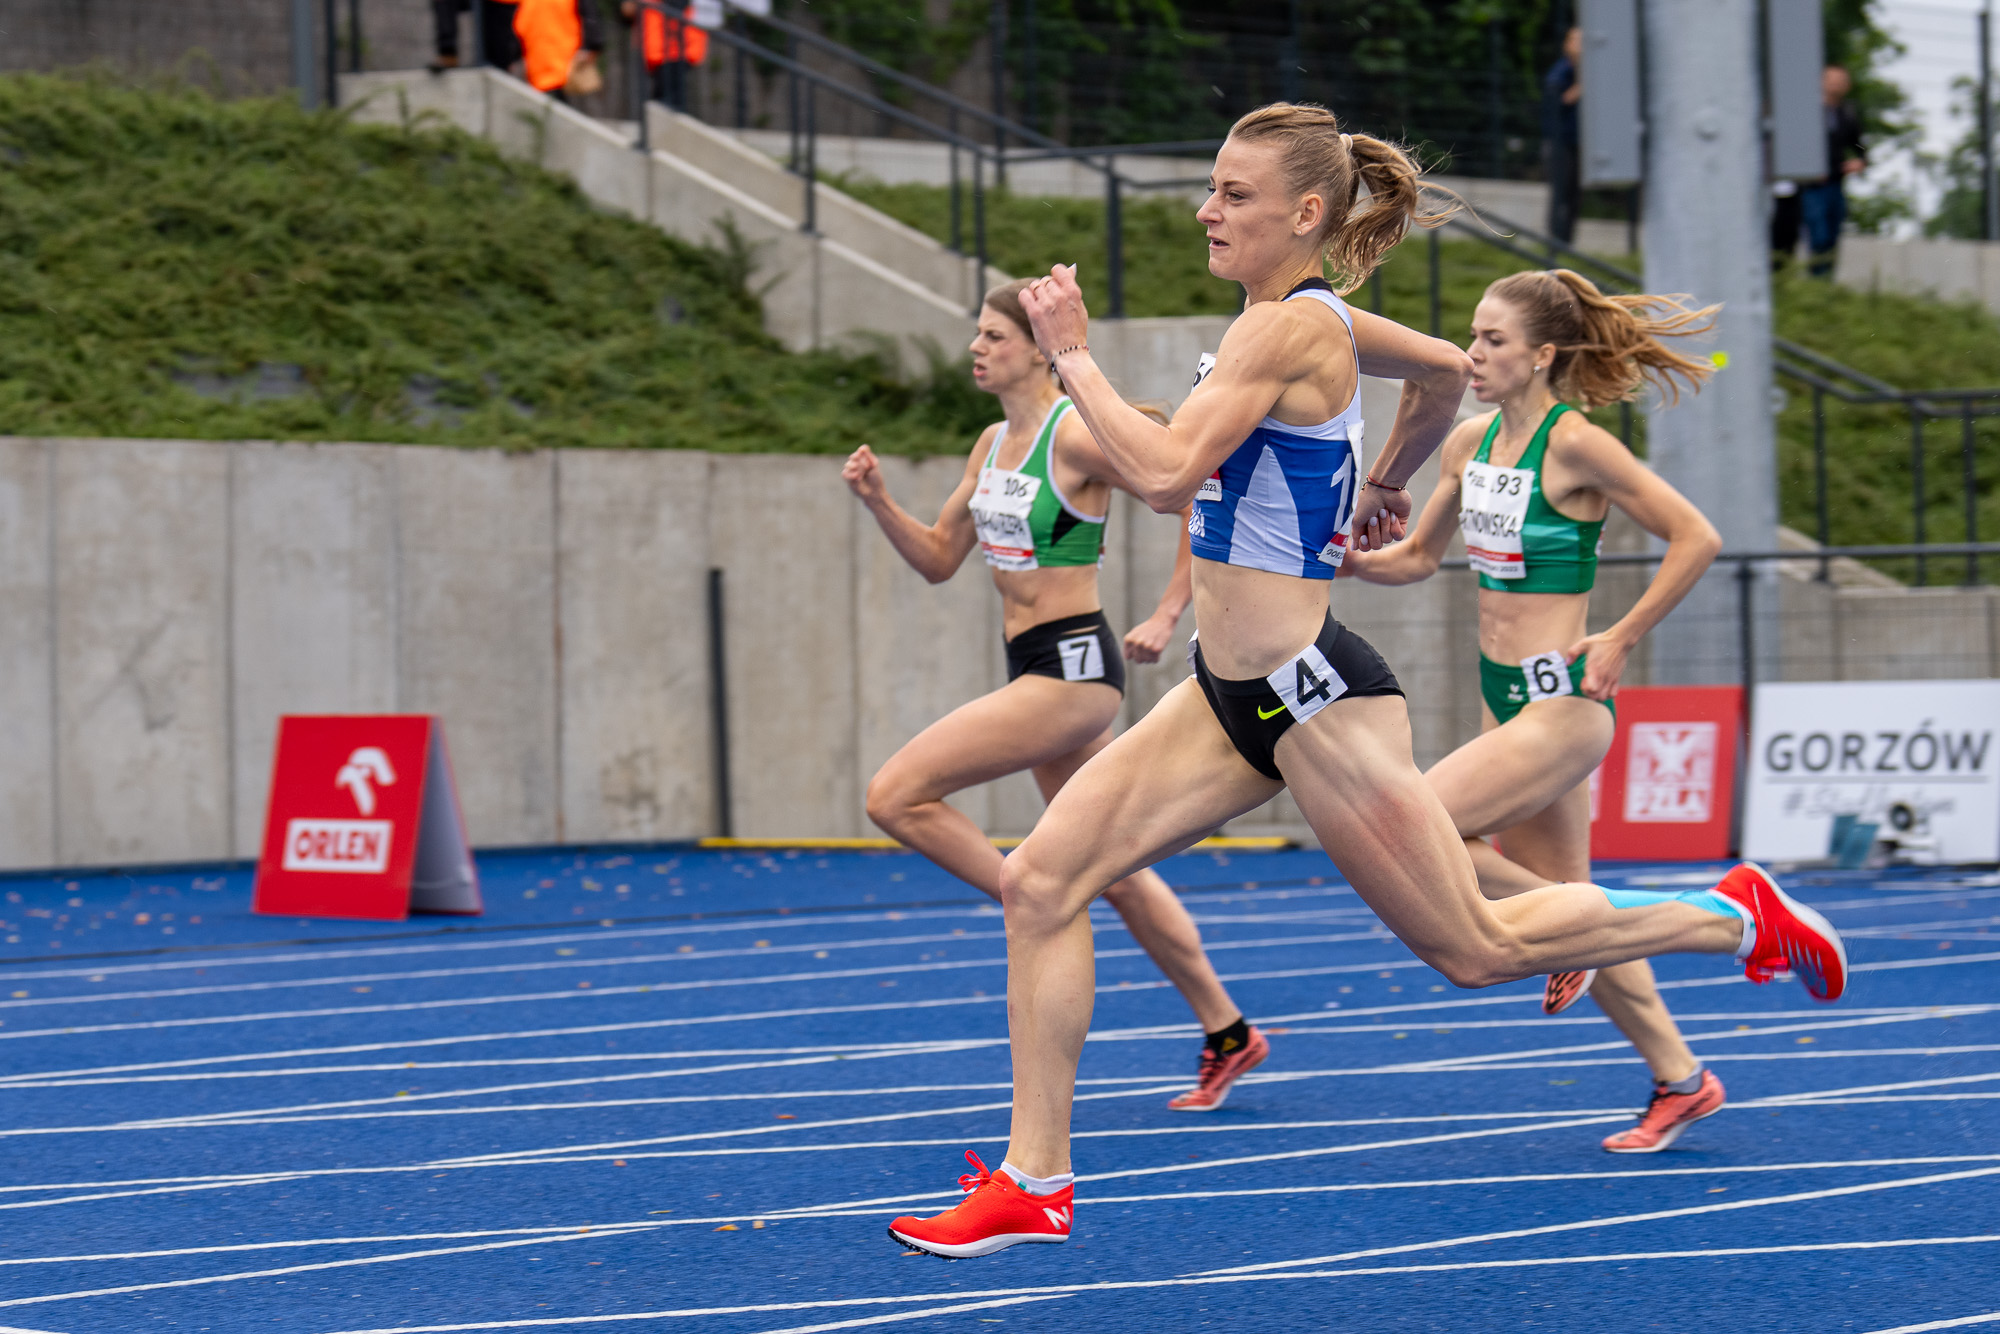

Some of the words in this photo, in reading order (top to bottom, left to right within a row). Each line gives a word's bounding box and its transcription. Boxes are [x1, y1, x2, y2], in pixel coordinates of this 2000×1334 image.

[1004, 477, 1030, 497] 106
[1070, 641, 1090, 675] 7
[1296, 658, 1331, 706] 4
[1534, 658, 1559, 694] 6
[1766, 718, 1991, 772] GORZÓW
[295, 829, 380, 862] ORLEN
